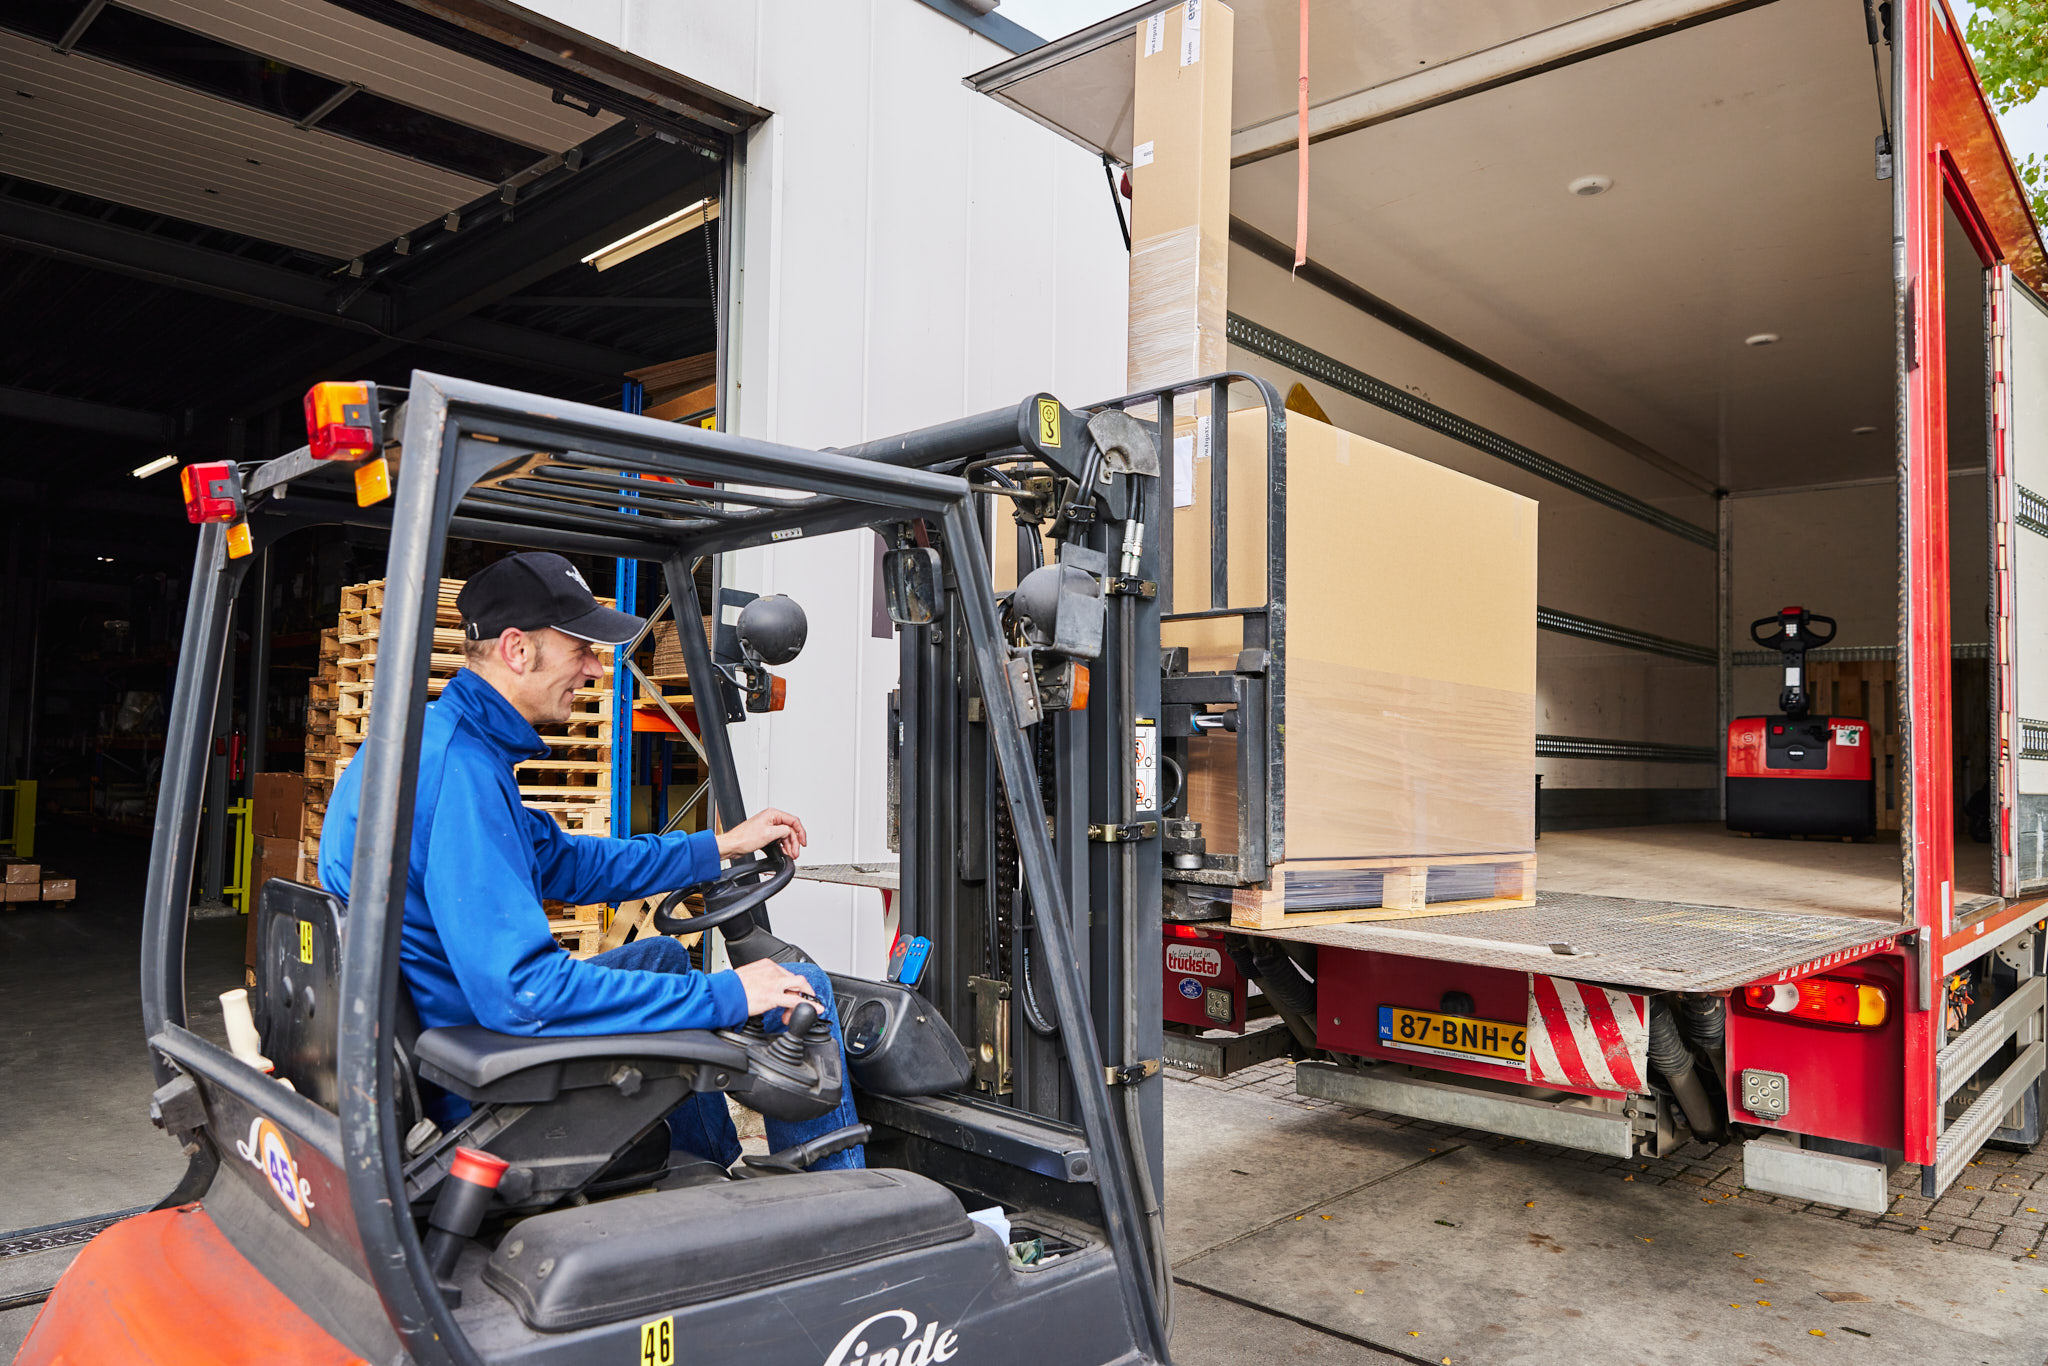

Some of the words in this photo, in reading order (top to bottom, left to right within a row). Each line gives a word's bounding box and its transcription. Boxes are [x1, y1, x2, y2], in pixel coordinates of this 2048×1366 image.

[302, 923, 311, 961] 46
[1192, 949, 1203, 958] het
[1203, 950, 1211, 958] in
[1168, 953, 1219, 975] truckstar
[1380, 1025, 1392, 1035] NL
[1400, 1014, 1526, 1055] 87-BNH-6
[269, 1149, 296, 1201] 45
[644, 1320, 671, 1366] 46
